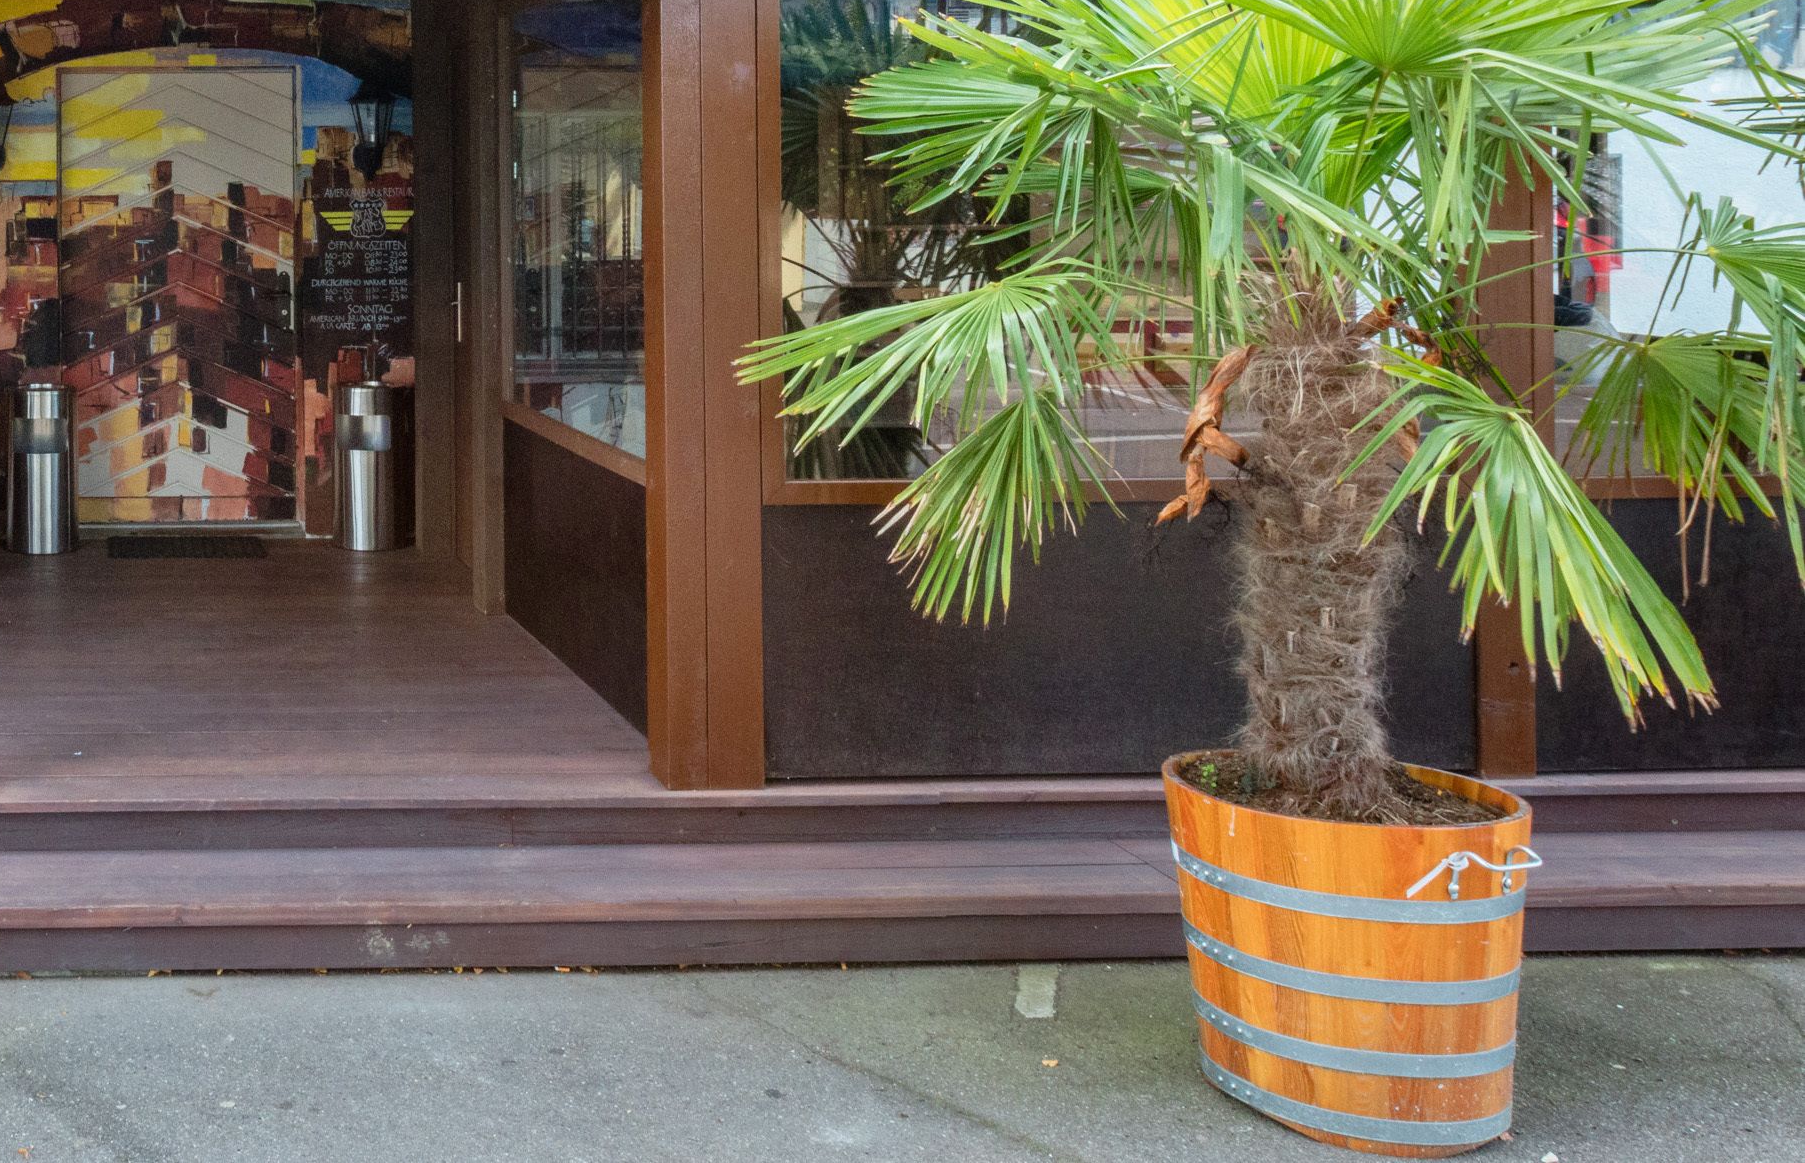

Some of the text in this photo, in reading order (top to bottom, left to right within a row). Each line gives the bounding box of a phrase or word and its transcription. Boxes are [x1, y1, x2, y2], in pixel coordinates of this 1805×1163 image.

[324, 187, 361, 198] AMERICAN
[362, 187, 376, 197] BAR
[354, 206, 380, 223] STARS
[353, 218, 384, 236] STRIPES
[347, 303, 393, 314] SONNTAG
[309, 315, 345, 323] AMERICAN
[347, 314, 376, 324] BRUNCH
[335, 322, 357, 331] CARTE
